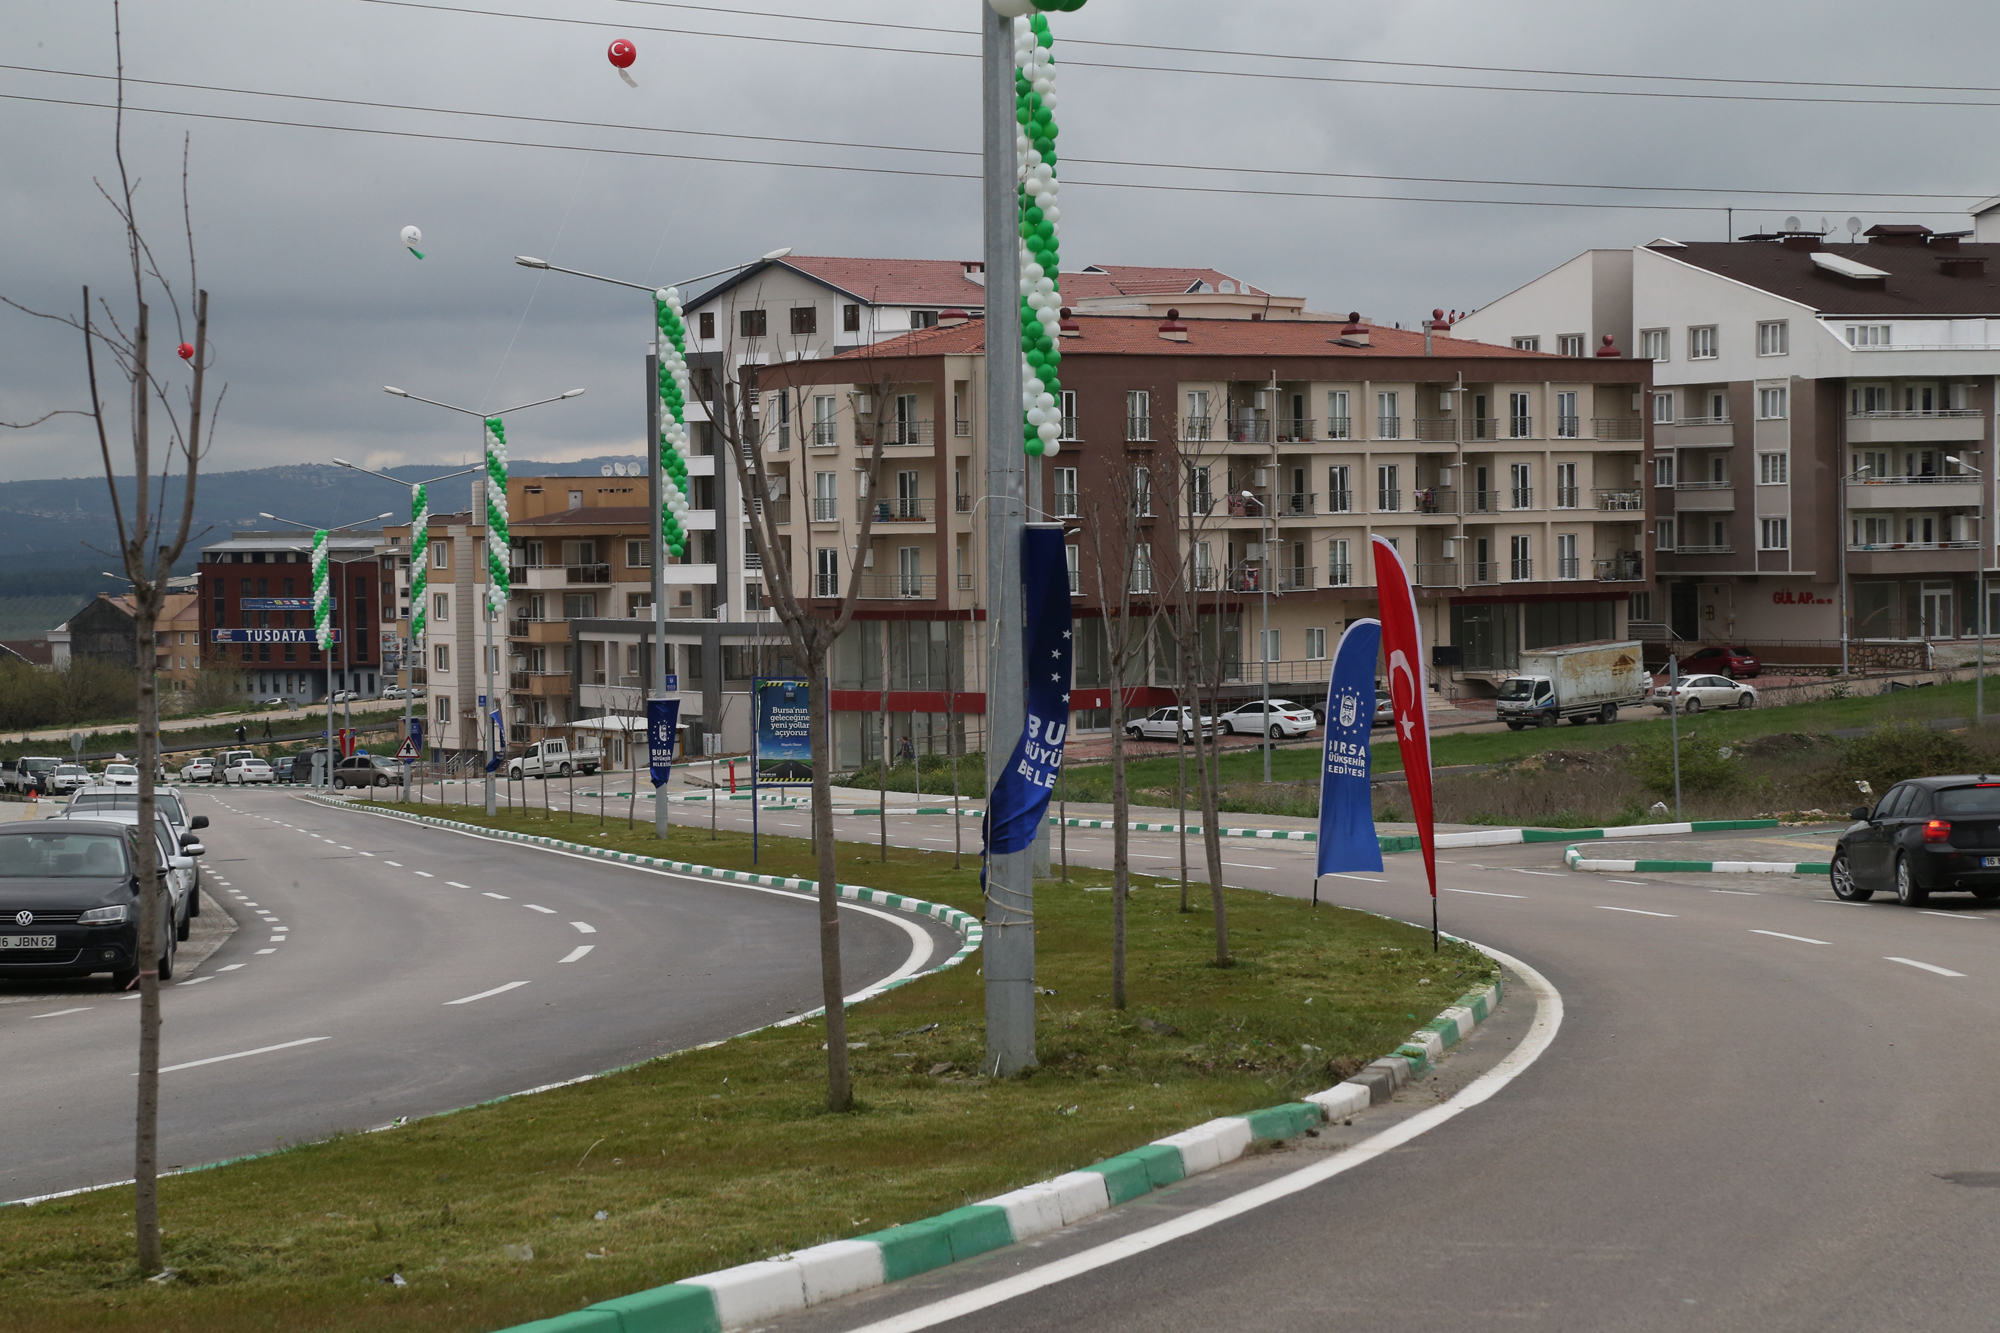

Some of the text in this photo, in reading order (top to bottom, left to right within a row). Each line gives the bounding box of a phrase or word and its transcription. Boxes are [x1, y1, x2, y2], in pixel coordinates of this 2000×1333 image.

[1773, 589, 1796, 604] GÜL
[246, 630, 306, 641] TUSDATA
[772, 706, 808, 714] Bursa'nın
[770, 714, 810, 722] geleceğine
[770, 721, 810, 730] yeni yollar
[652, 748, 671, 756] BURA
[1986, 857, 1996, 865] 16
[14, 937, 39, 947] JBN
[41, 936, 55, 947] 62
